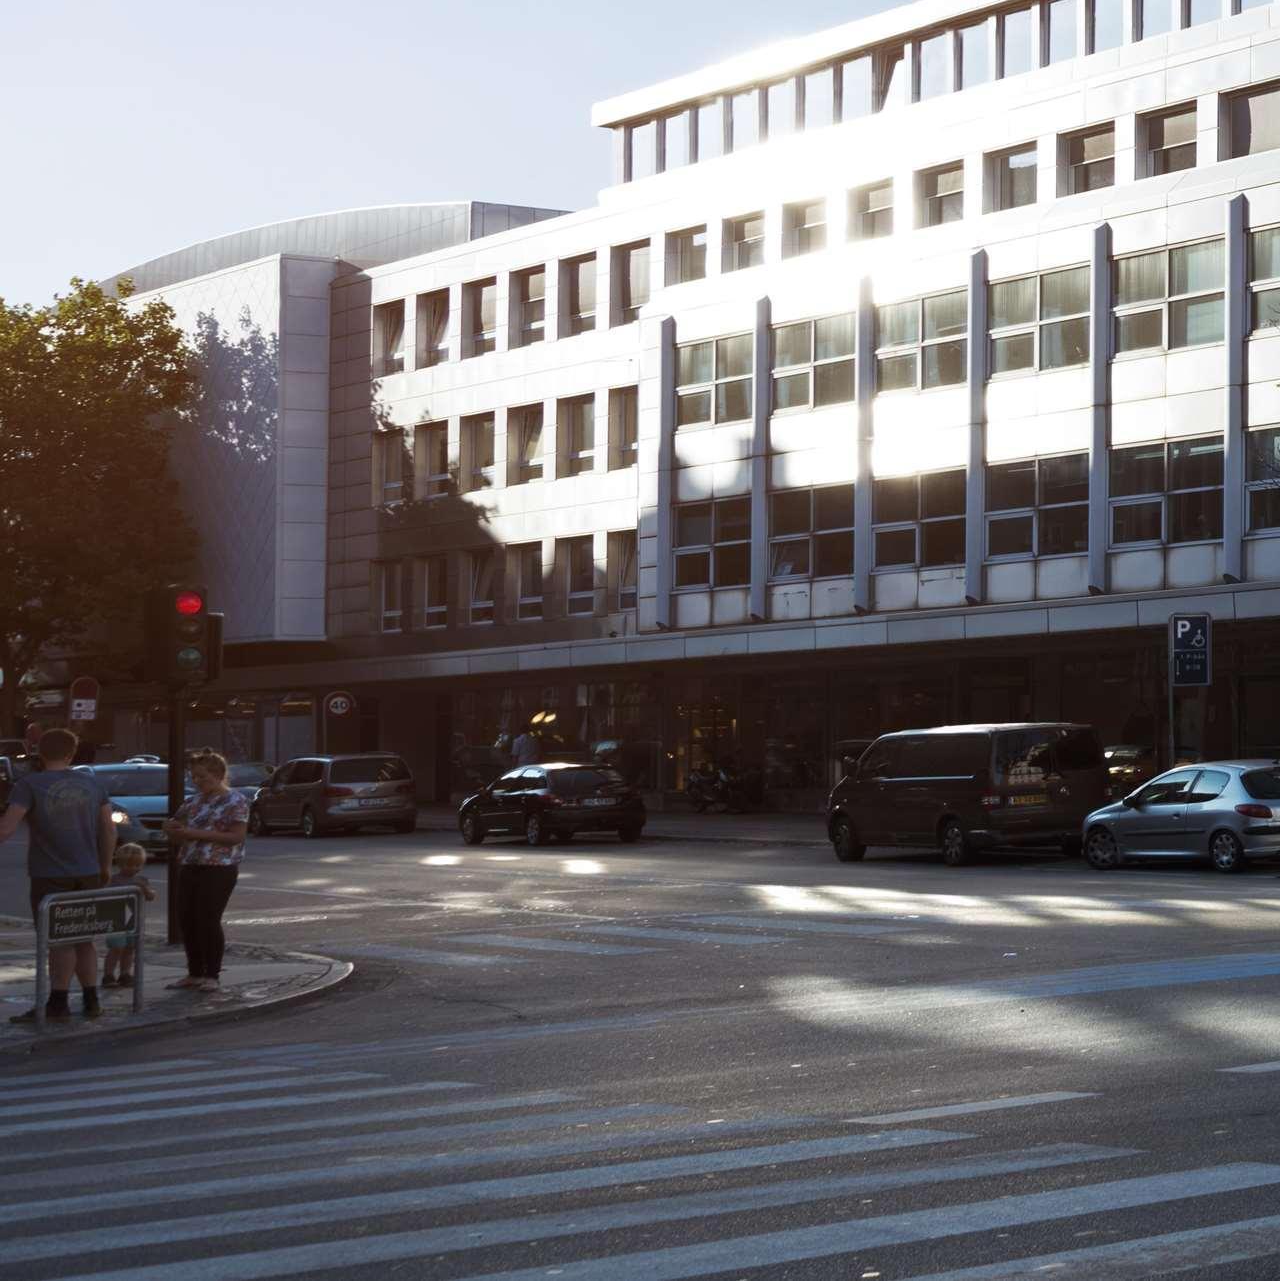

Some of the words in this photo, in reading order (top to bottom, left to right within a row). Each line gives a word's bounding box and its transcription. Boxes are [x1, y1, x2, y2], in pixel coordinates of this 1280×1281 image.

[1176, 620, 1191, 639] P
[330, 700, 348, 710] 40
[55, 907, 85, 920] Retten
[55, 919, 114, 934] Frederiksberg
